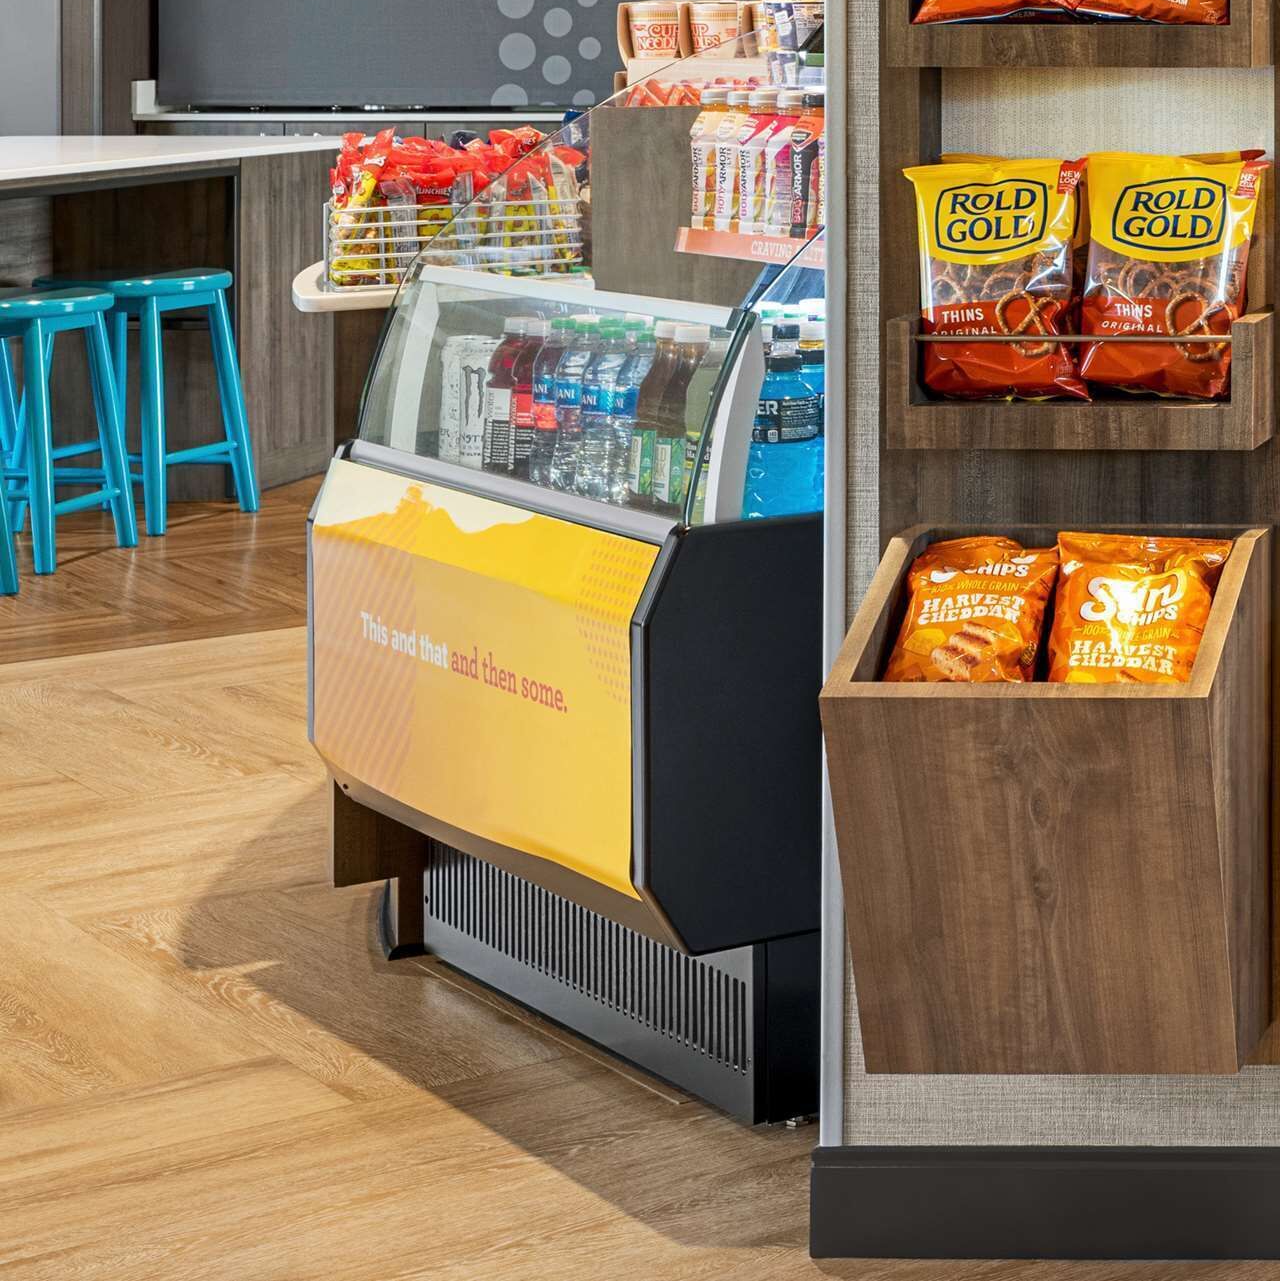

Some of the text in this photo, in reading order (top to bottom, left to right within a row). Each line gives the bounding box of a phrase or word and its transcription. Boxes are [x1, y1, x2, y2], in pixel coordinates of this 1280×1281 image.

[1060, 170, 1081, 179] NEW
[793, 153, 803, 224] BODYARMOR
[950, 187, 1037, 216] ROLD
[1130, 187, 1216, 214] ROLD
[946, 214, 1035, 243] GOLD
[1123, 214, 1213, 239] GOLD
[941, 308, 985, 324] THINS
[1114, 303, 1153, 319] THINS
[1101, 320, 1164, 334] ORIGINAL
[957, 581, 987, 591] WHOLE
[989, 582, 1020, 591] GRAIN
[922, 593, 1025, 613] HARVEST
[917, 605, 1021, 625] CHEDDAR
[1072, 640, 1177, 661] HARVEST
[360, 611, 568, 713] This and that and then some.
[1068, 654, 1175, 675] CHEDDAR
